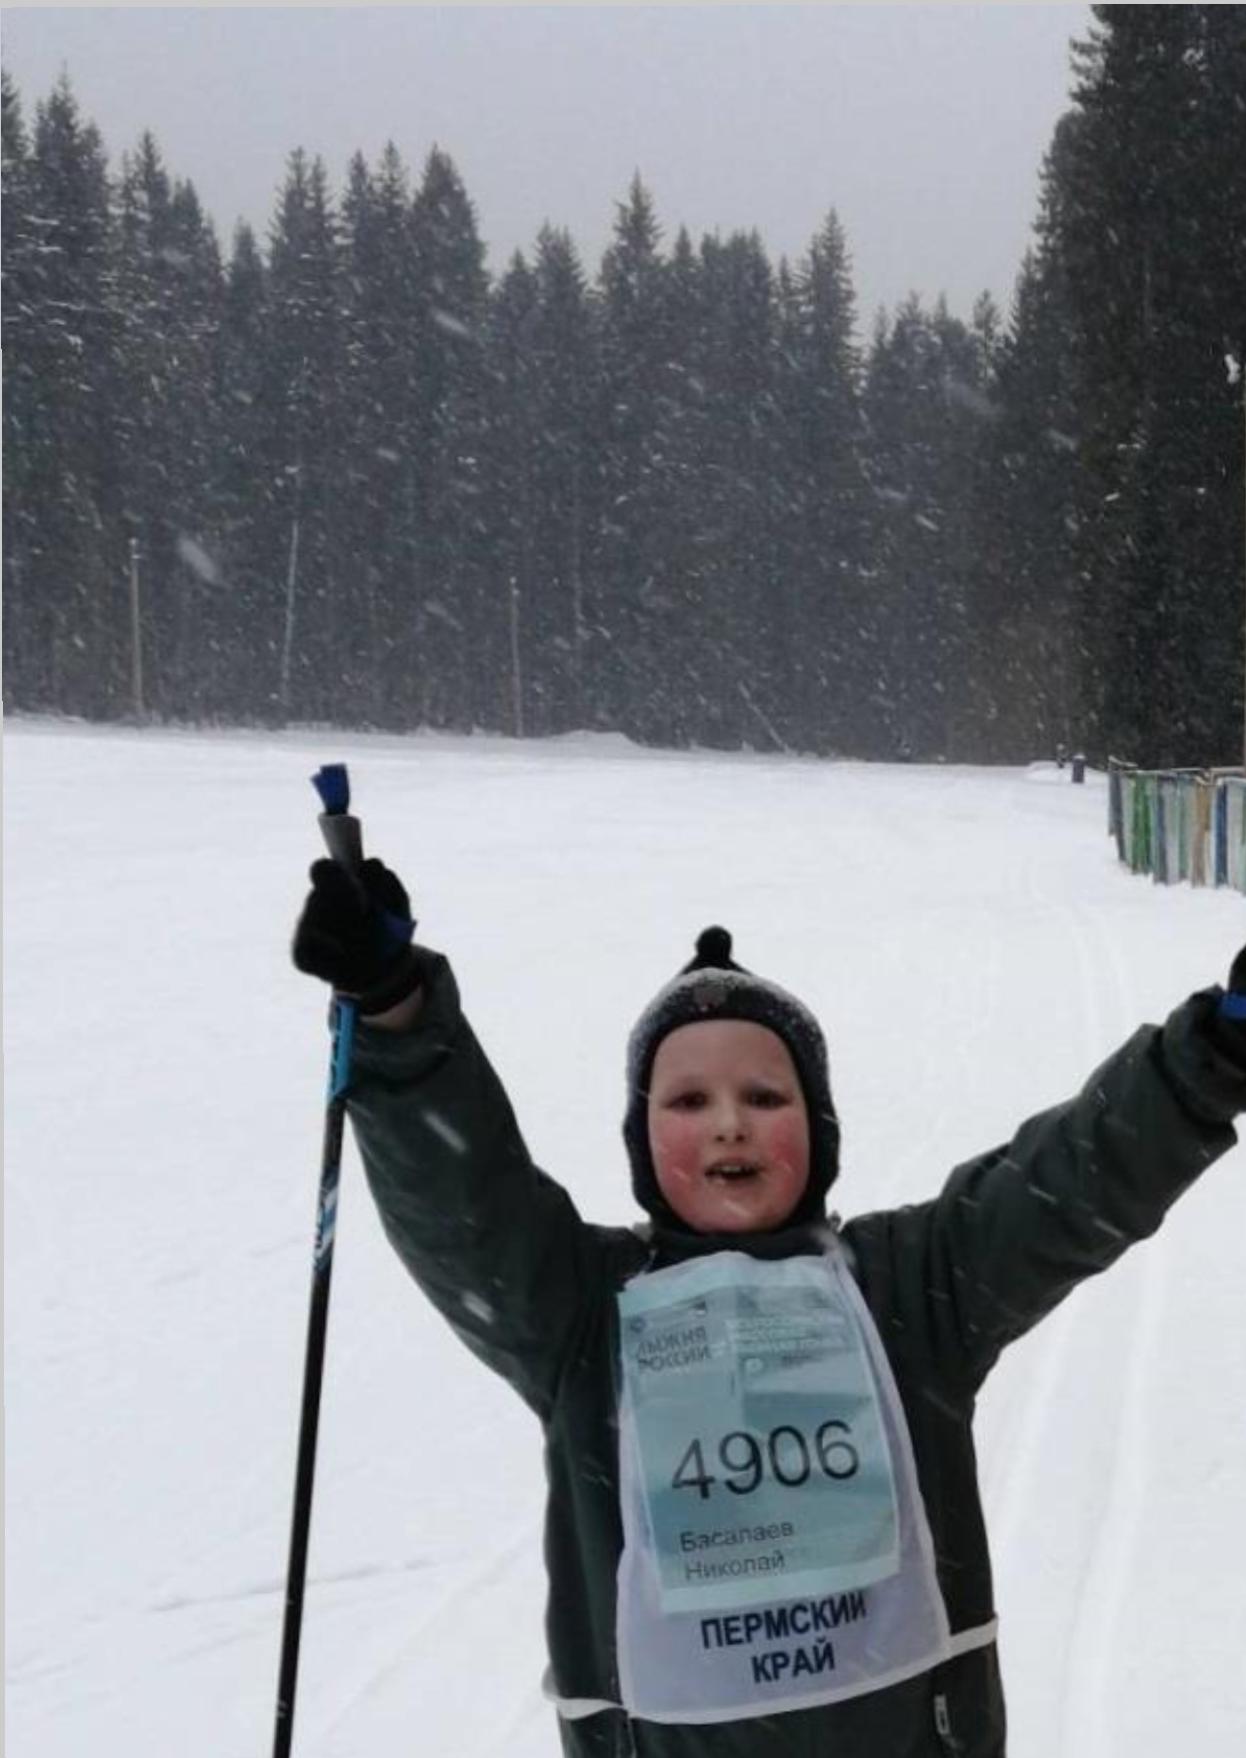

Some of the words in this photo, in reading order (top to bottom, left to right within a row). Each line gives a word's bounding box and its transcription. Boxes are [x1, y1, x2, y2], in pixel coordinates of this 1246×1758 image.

[671, 1419, 861, 1501] 4906
[679, 1519, 795, 1553] Басалаев
[684, 1549, 785, 1582] Николай
[750, 1641, 836, 1684] КРАЙ
